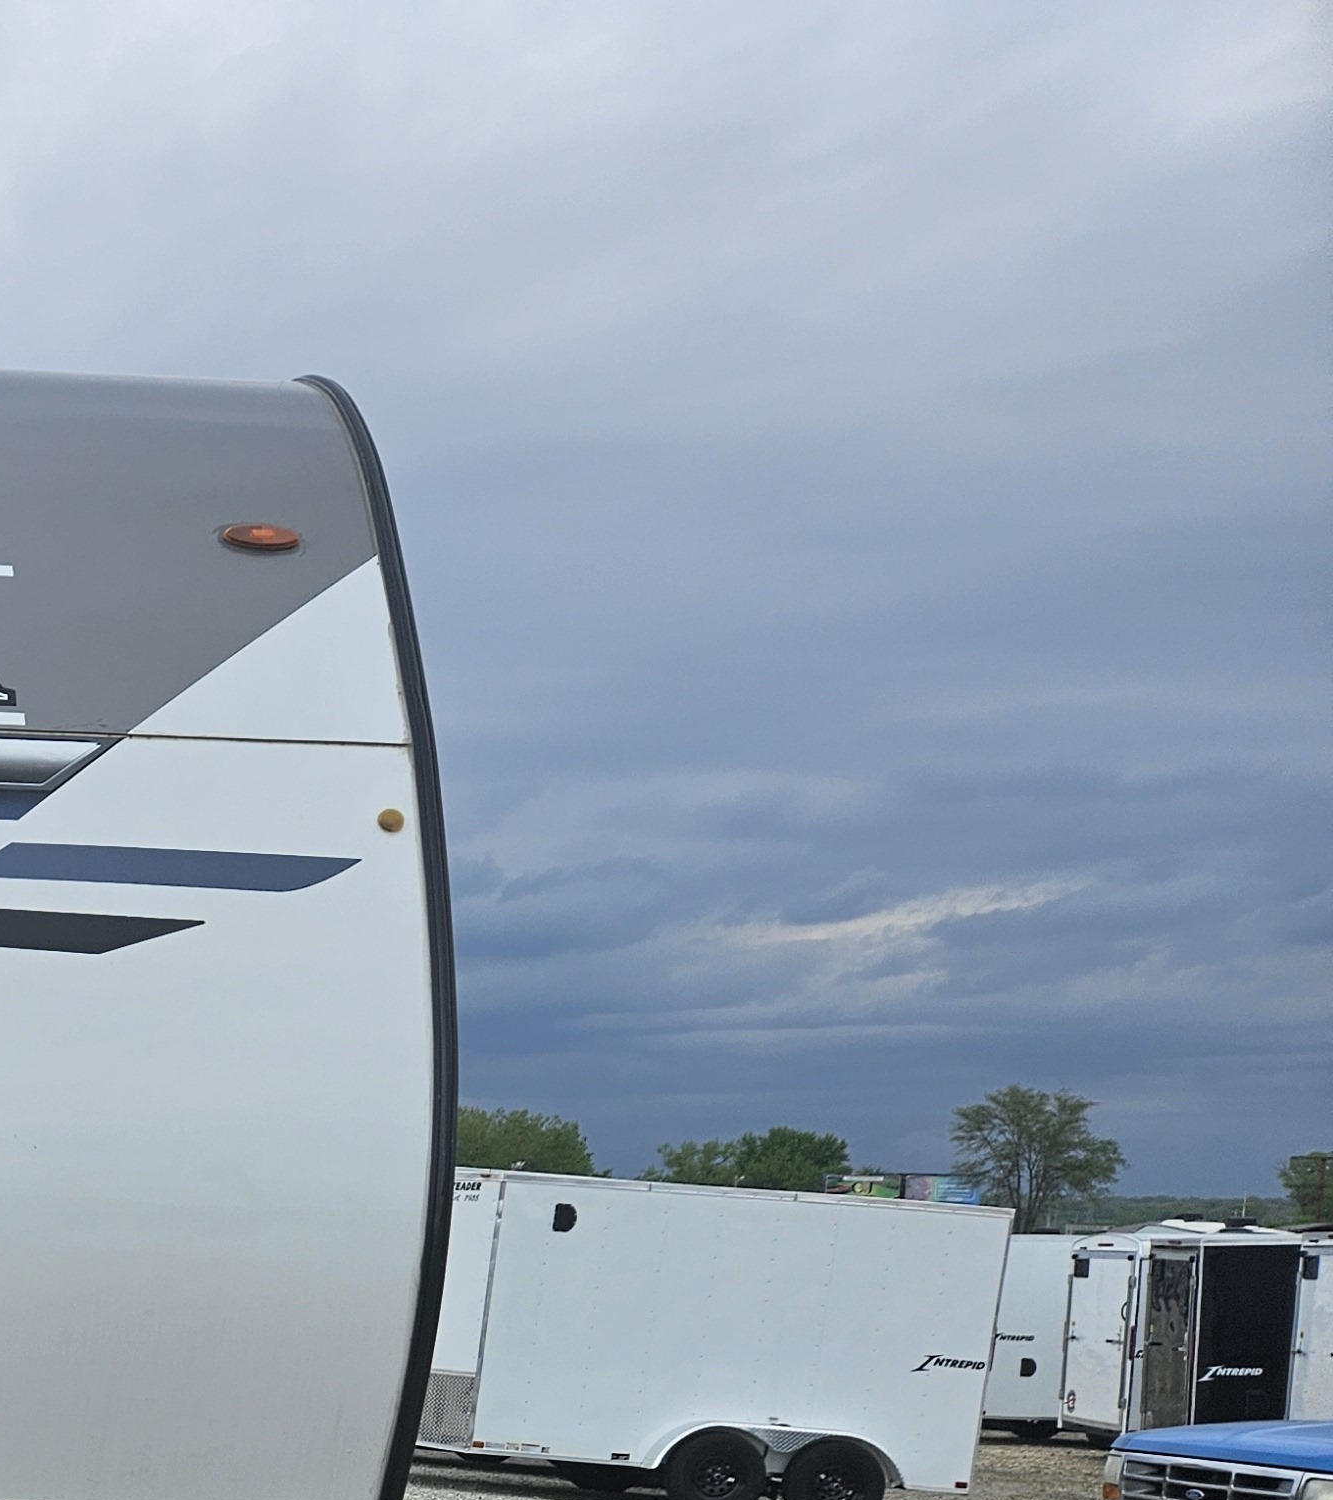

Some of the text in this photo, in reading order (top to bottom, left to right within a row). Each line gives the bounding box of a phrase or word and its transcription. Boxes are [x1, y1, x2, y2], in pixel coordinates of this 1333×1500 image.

[453, 1181, 482, 1191] EADER
[910, 1353, 986, 1373] INTREPID
[1198, 1365, 1264, 1382] INTREPID
